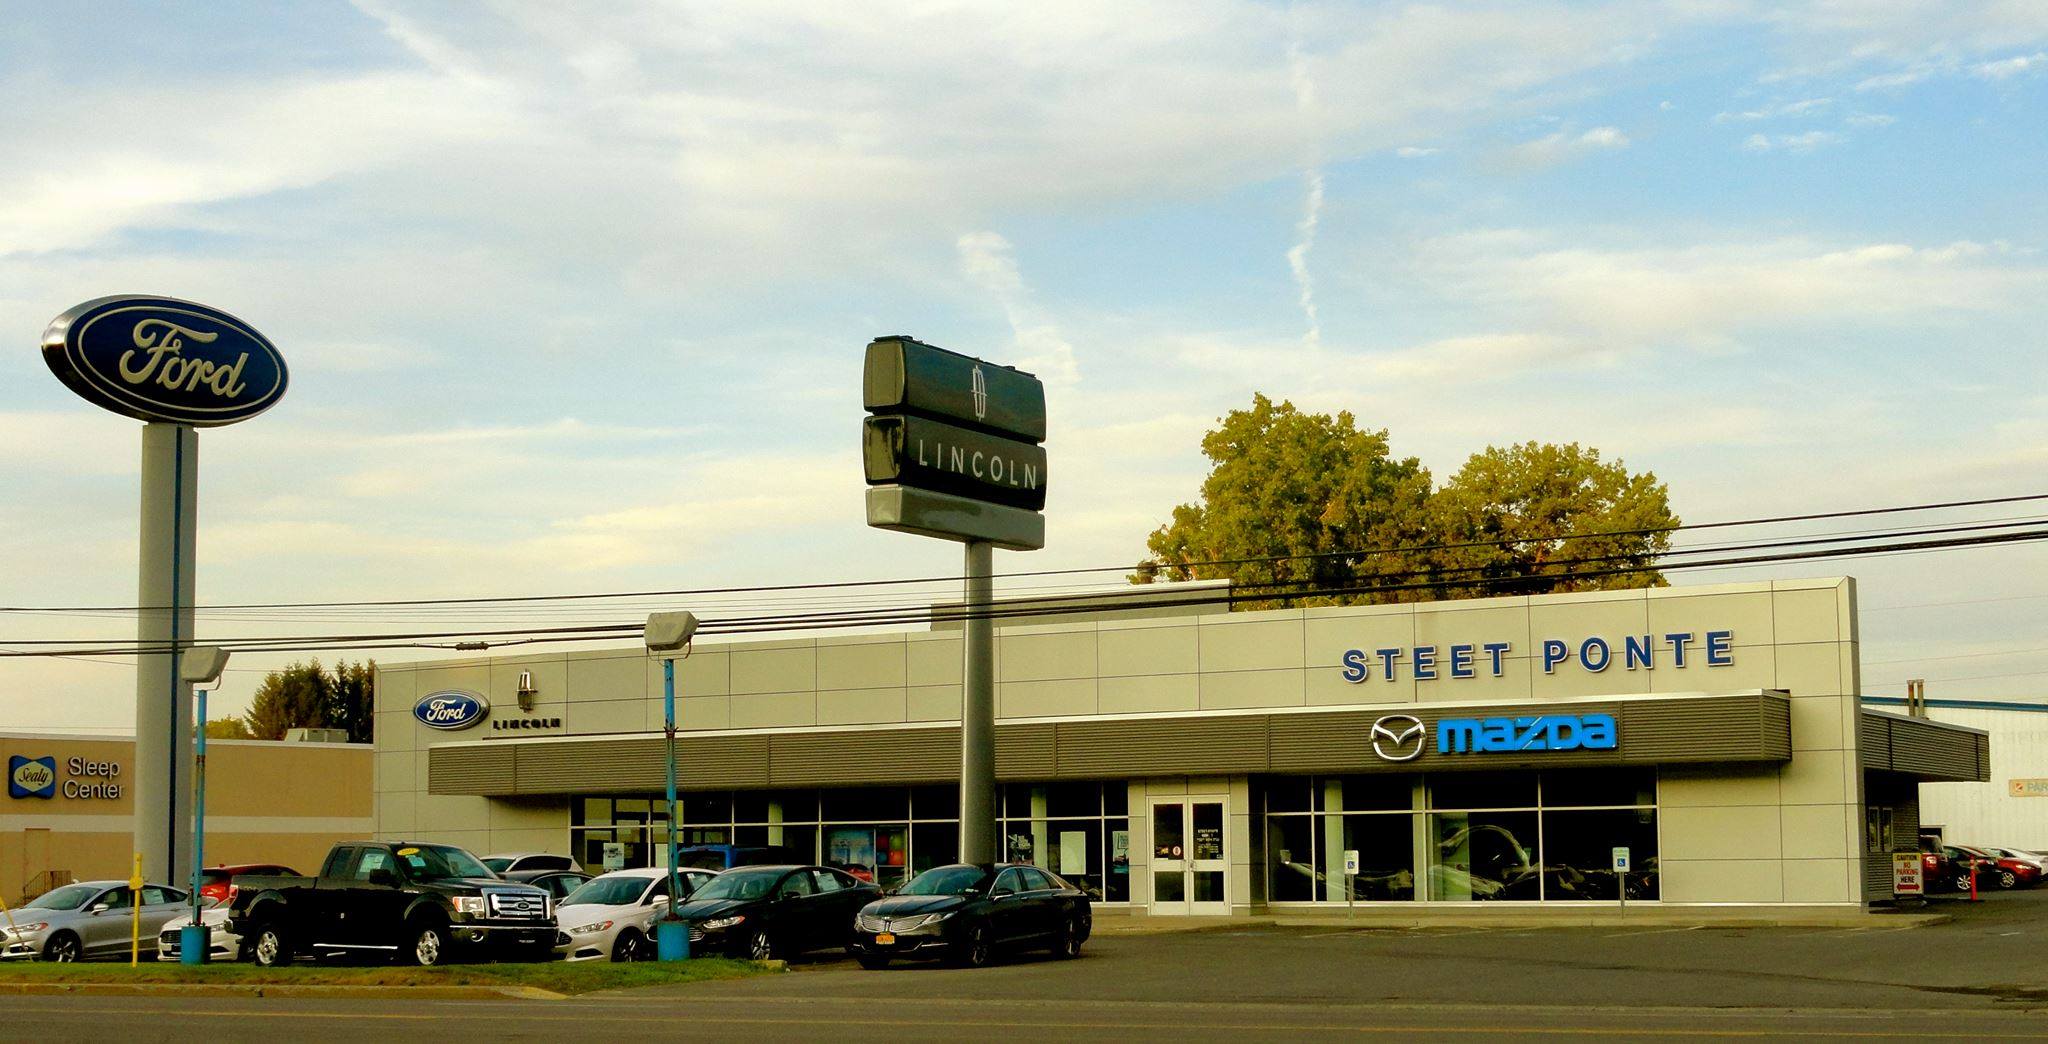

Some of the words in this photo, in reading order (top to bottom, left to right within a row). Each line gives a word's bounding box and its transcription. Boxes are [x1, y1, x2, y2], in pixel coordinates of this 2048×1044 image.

[118, 318, 249, 399] Ford
[919, 439, 1036, 490] LINCOLN
[1342, 641, 1510, 683] STEET
[1543, 628, 1734, 675] PONTE
[426, 699, 466, 721] Ford
[493, 717, 561, 730] LINCOLN
[1437, 714, 1617, 754] mazda
[19, 767, 49, 786] Sealy
[68, 756, 121, 780] Sleep
[63, 779, 124, 800] Center
